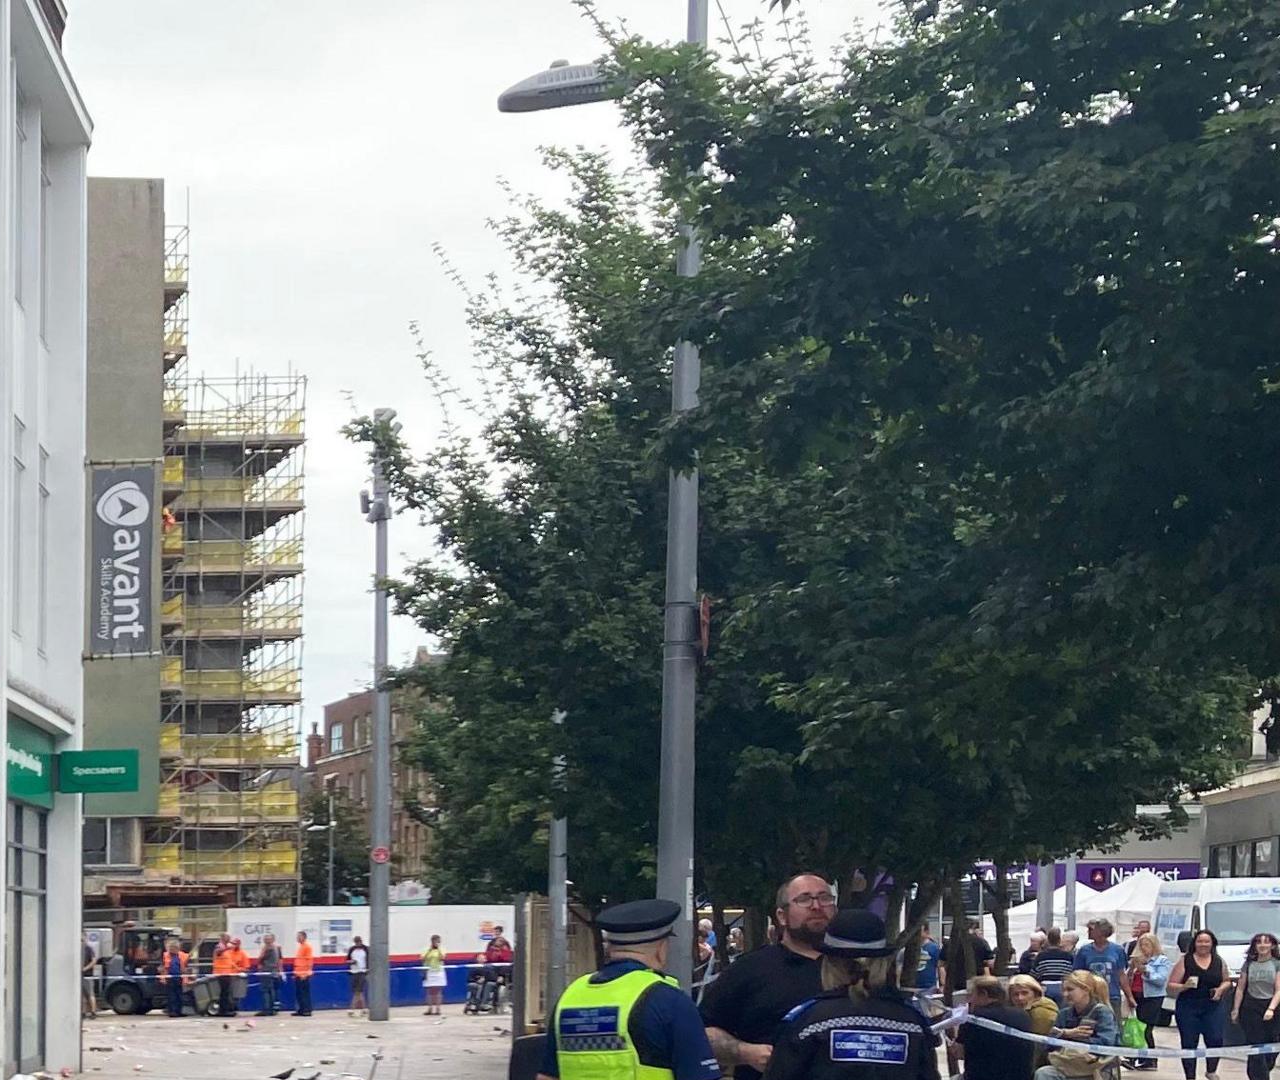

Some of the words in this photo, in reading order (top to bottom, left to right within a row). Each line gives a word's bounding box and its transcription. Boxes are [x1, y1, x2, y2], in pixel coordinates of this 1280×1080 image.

[100, 558, 113, 587] Skills
[112, 528, 145, 639] avant
[97, 588, 113, 640] Academy
[72, 766, 127, 776] Specsavers
[244, 924, 272, 935] GATE
